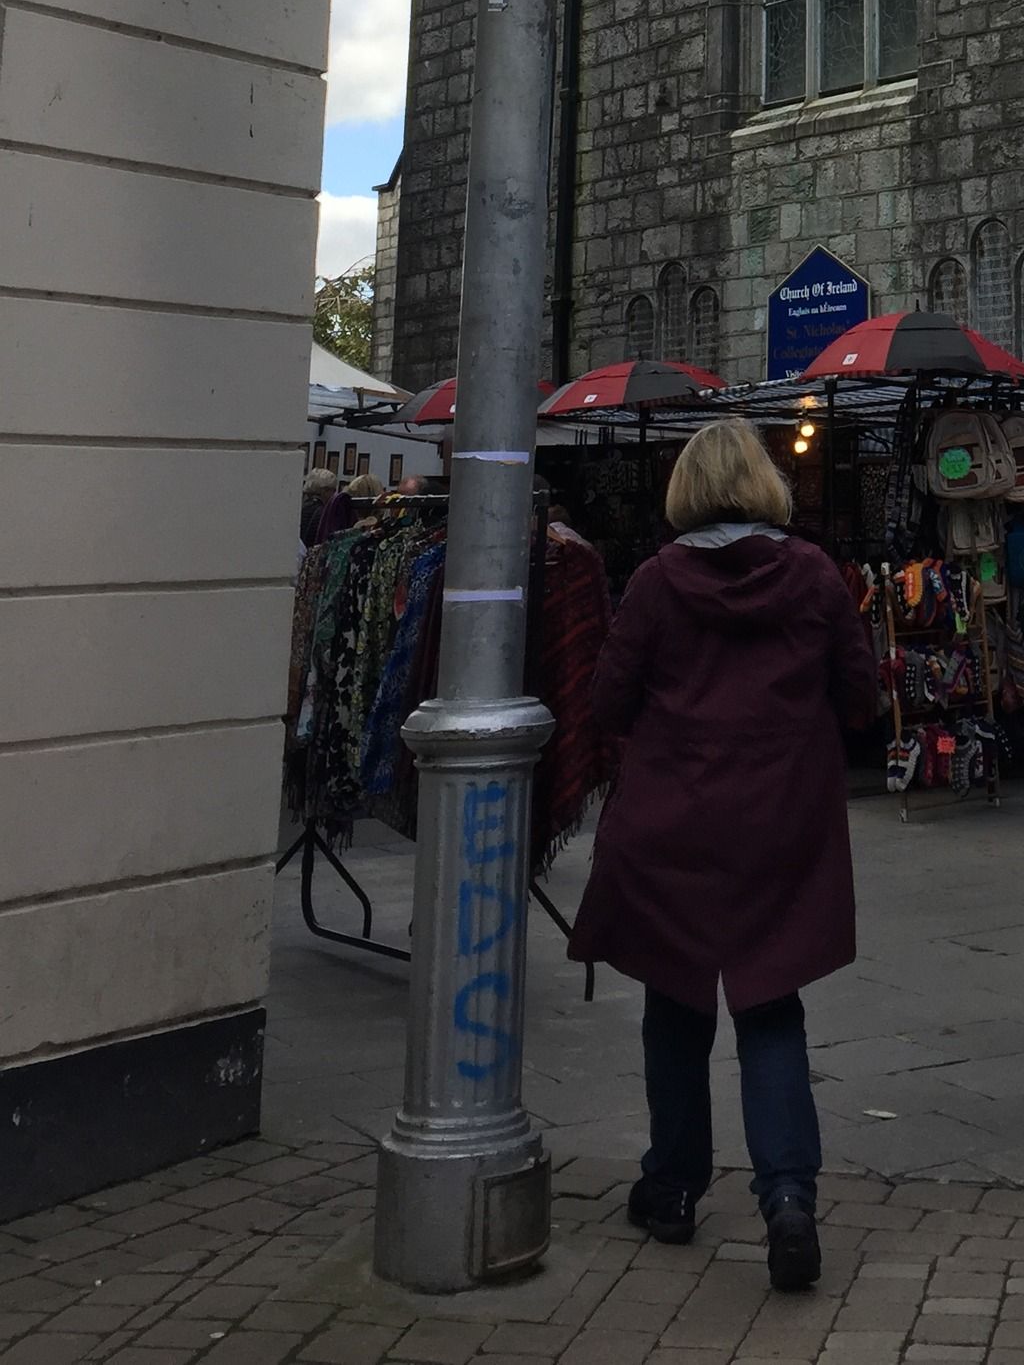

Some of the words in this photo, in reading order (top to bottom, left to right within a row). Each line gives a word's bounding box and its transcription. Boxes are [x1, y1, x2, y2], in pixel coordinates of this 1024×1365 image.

[780, 284, 810, 302] Church
[812, 282, 825, 297] Of
[826, 279, 858, 295] Ireland
